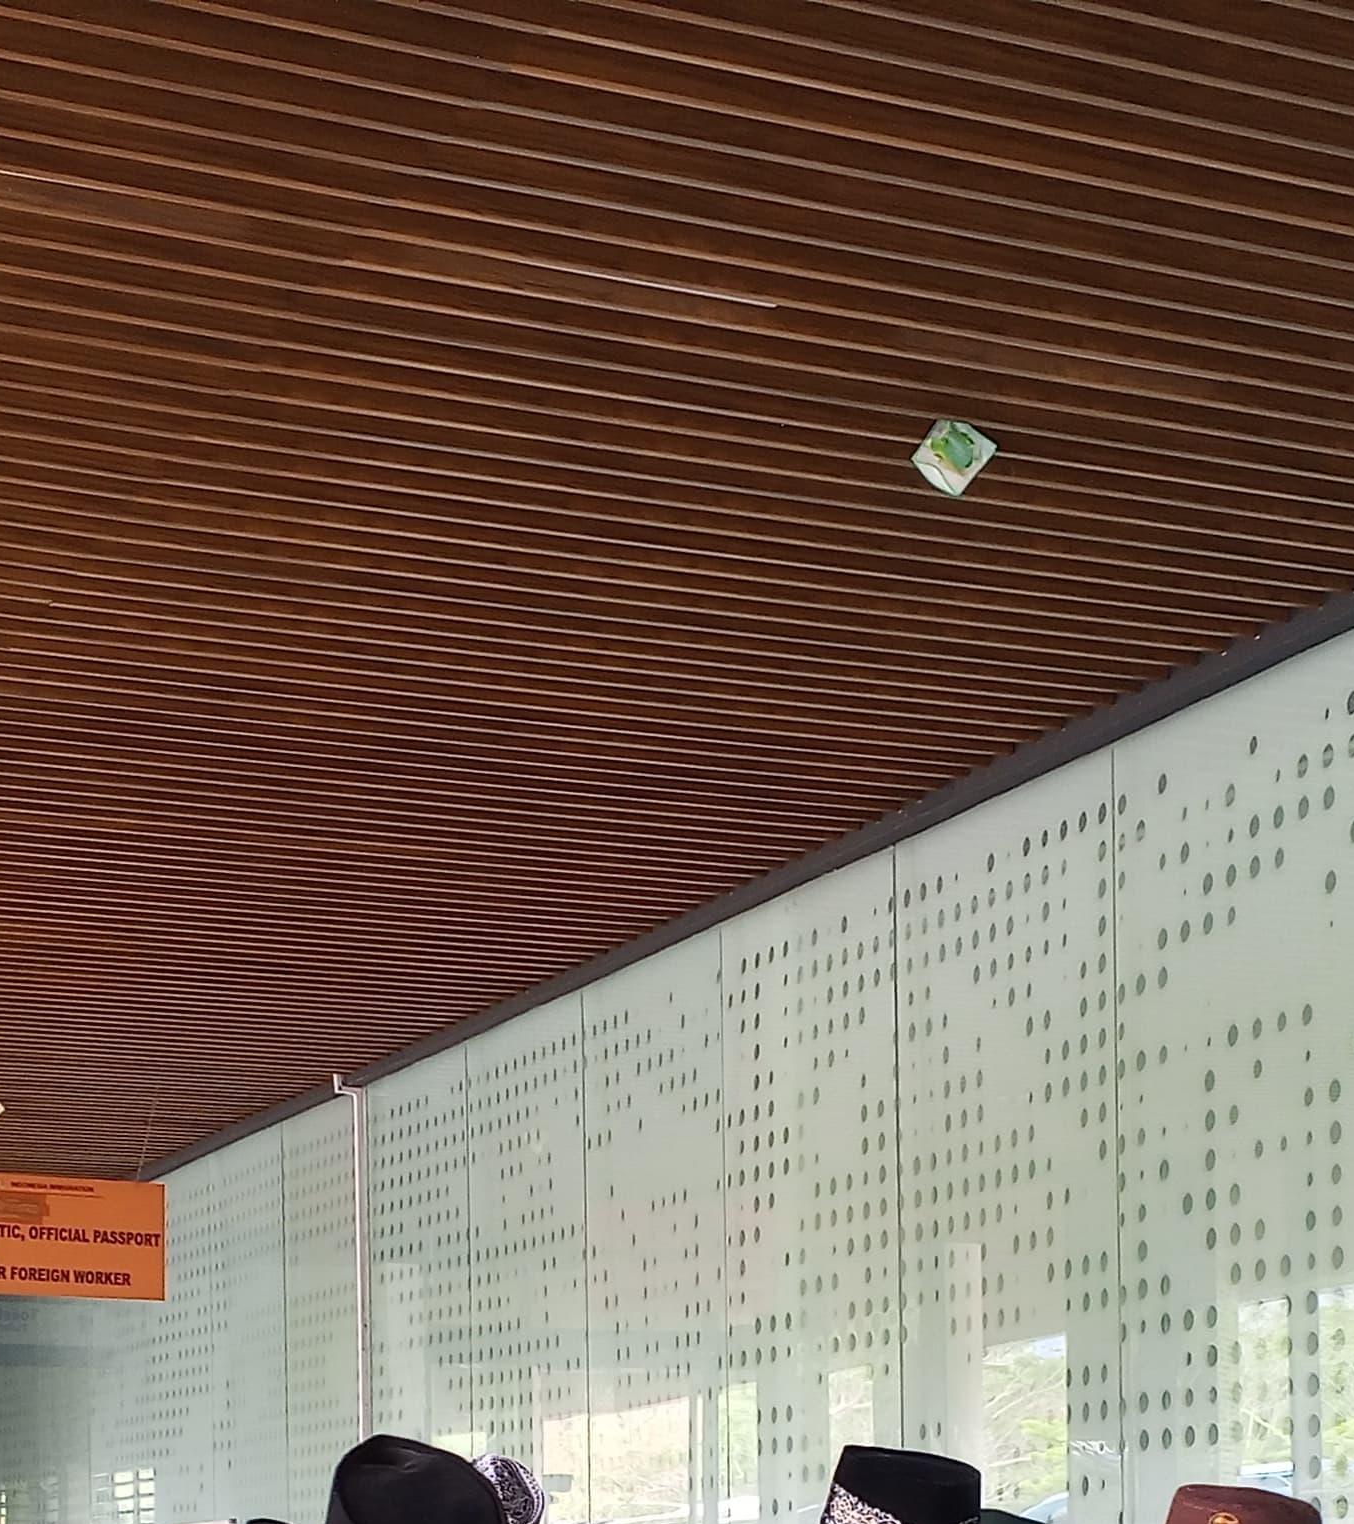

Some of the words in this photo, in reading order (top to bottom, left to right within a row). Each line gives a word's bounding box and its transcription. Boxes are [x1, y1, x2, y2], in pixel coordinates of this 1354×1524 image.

[29, 1227, 89, 1243] OFFICIAL
[93, 1230, 161, 1247] PASSPORT
[10, 1267, 70, 1283] FOREIGN
[73, 1271, 131, 1286] WORKER
